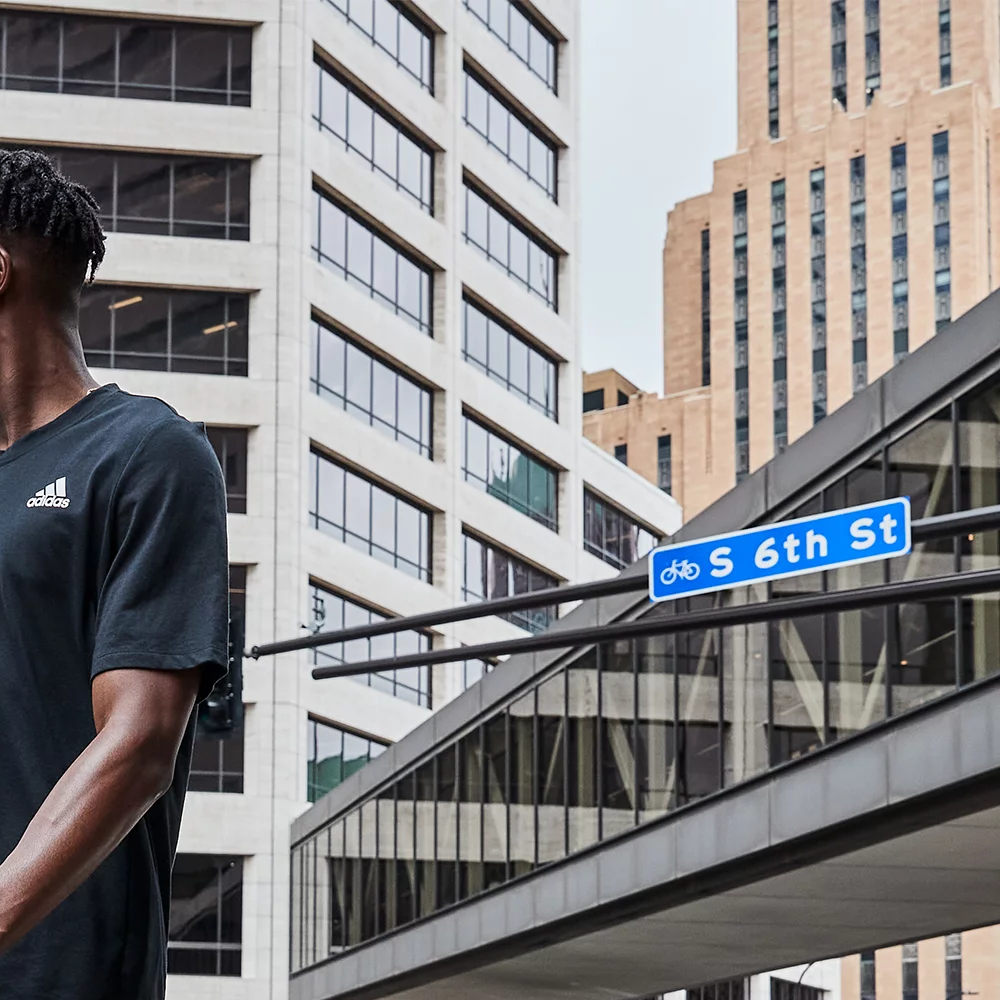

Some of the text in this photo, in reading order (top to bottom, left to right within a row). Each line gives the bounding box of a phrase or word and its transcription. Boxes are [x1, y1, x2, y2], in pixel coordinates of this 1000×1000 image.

[26, 495, 70, 508] adidas
[709, 513, 898, 578] S 6th St
